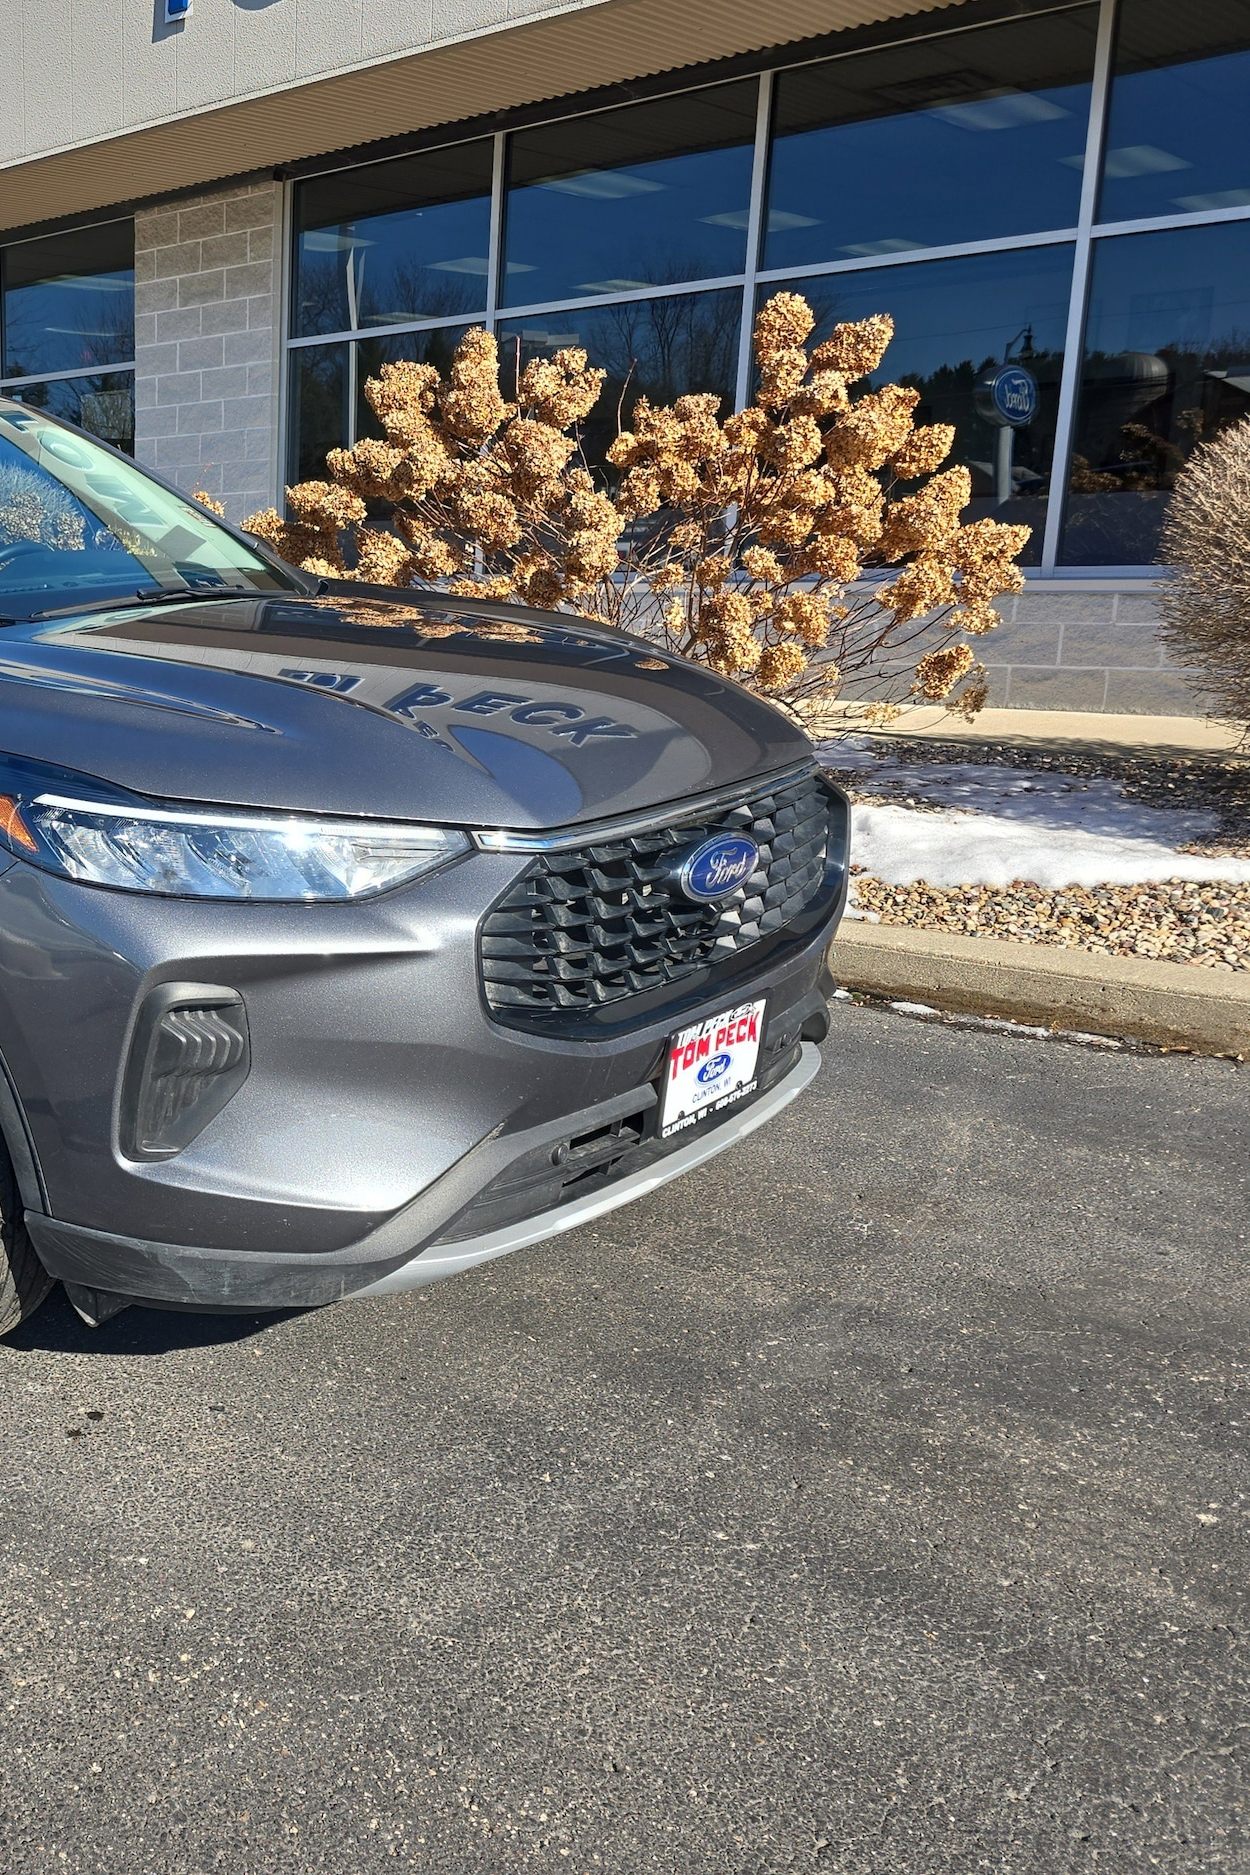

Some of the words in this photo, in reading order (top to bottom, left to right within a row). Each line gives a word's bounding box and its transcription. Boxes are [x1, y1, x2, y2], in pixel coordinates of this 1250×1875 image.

[705, 847, 748, 889] Ford
[671, 1034, 711, 1081] TOM
[715, 1011, 760, 1052] PECK
[703, 1056, 727, 1081] Ford
